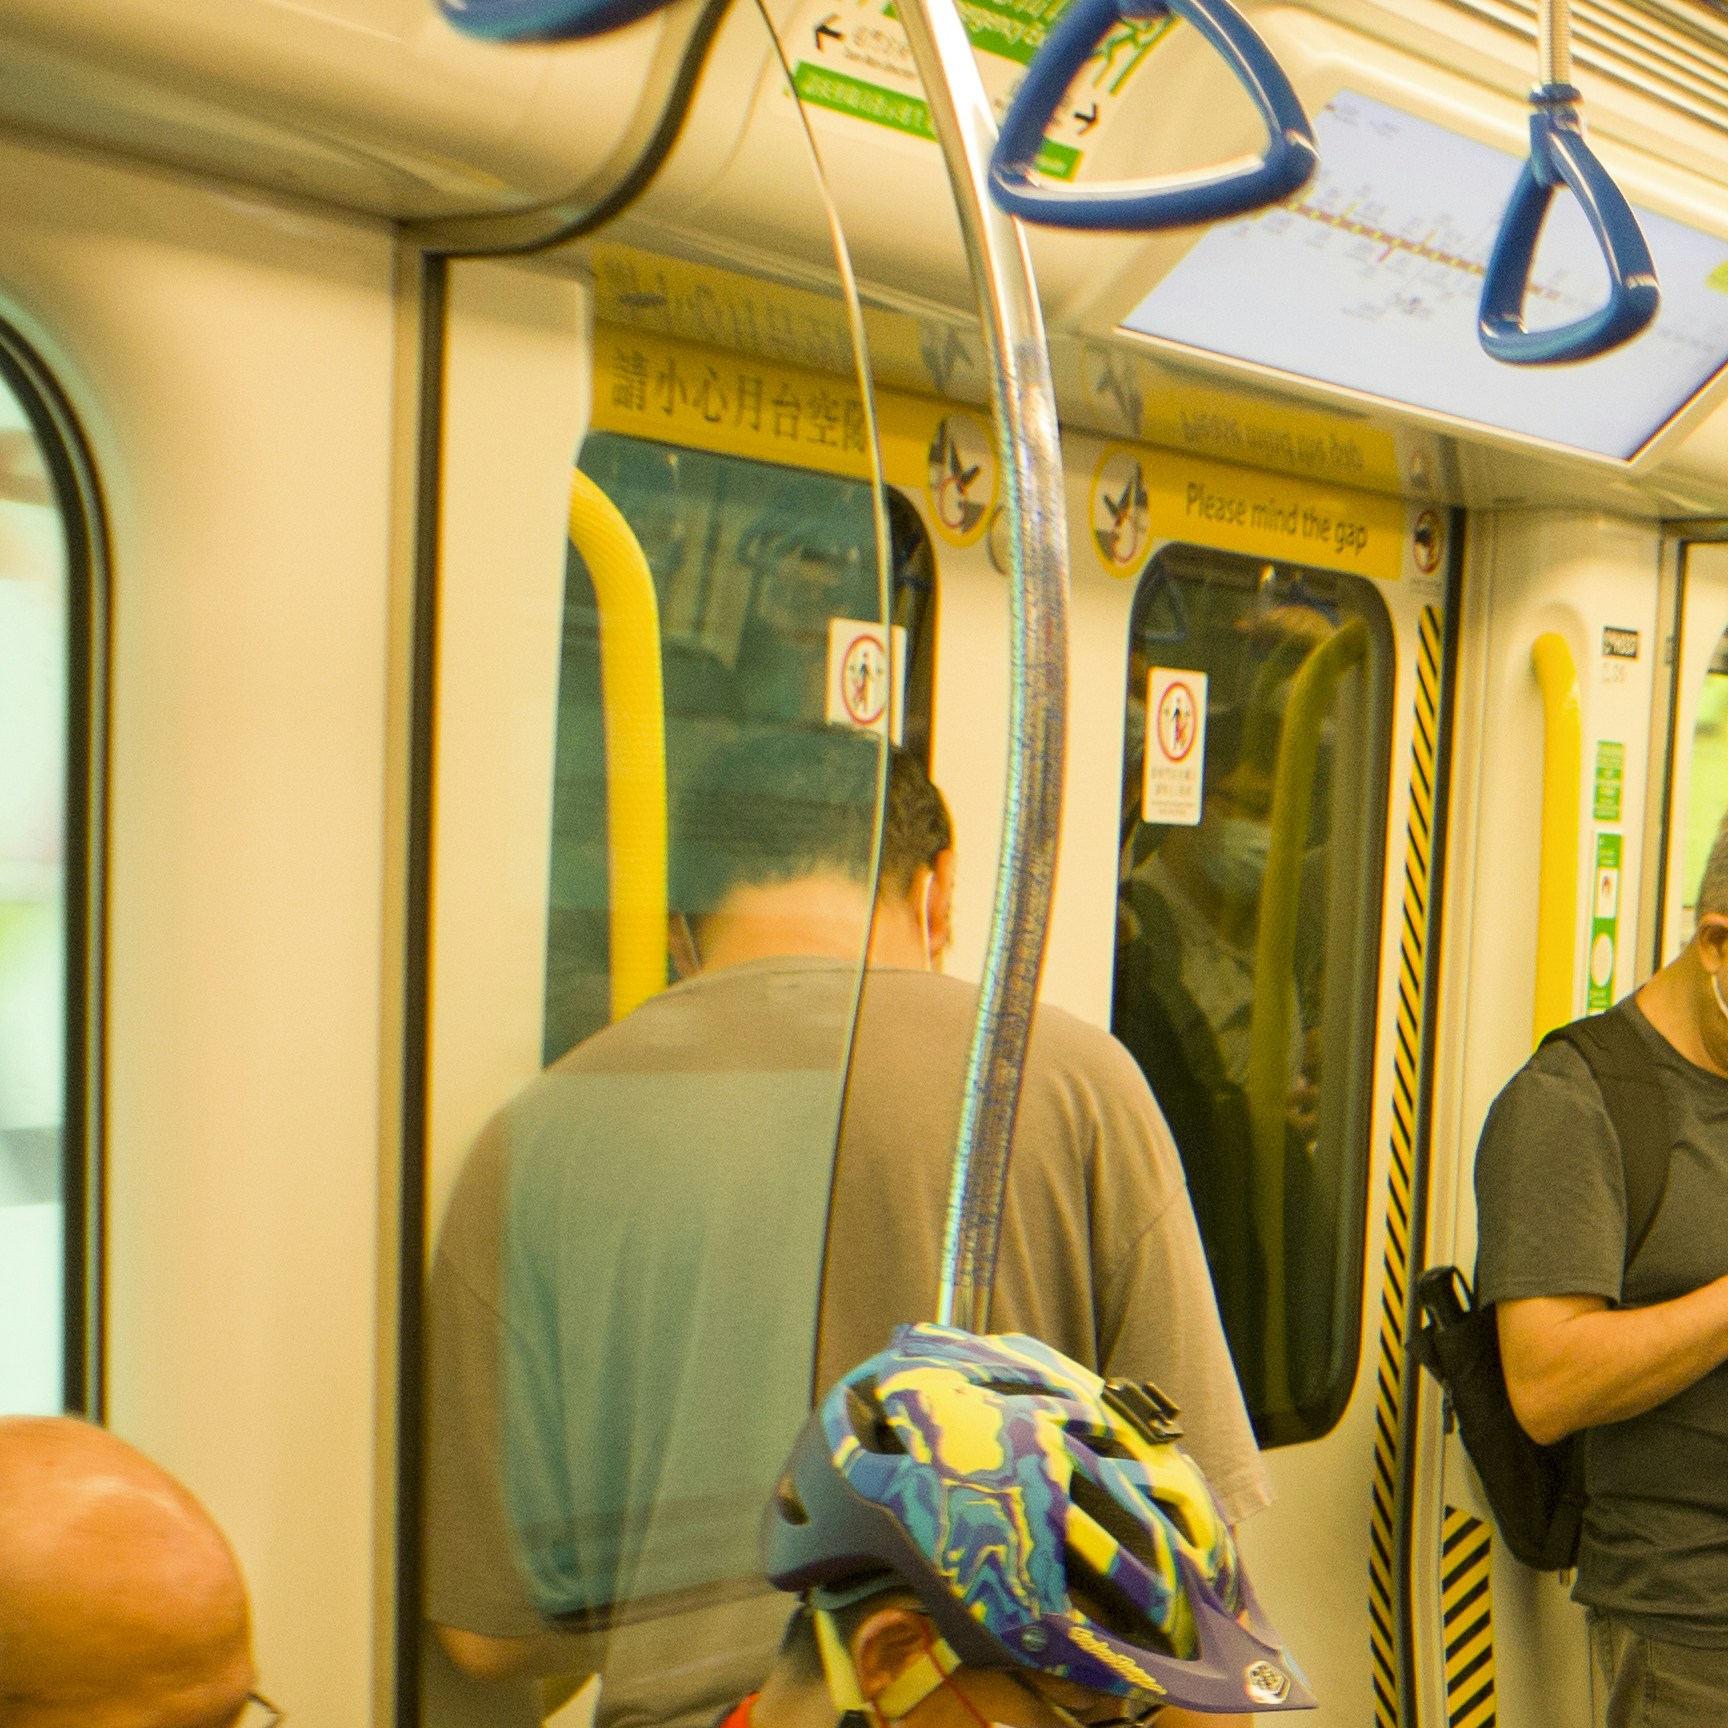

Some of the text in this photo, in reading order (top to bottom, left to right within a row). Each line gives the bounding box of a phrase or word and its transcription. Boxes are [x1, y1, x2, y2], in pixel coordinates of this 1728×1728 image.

[1185, 481, 1369, 556] Please mind the gap
